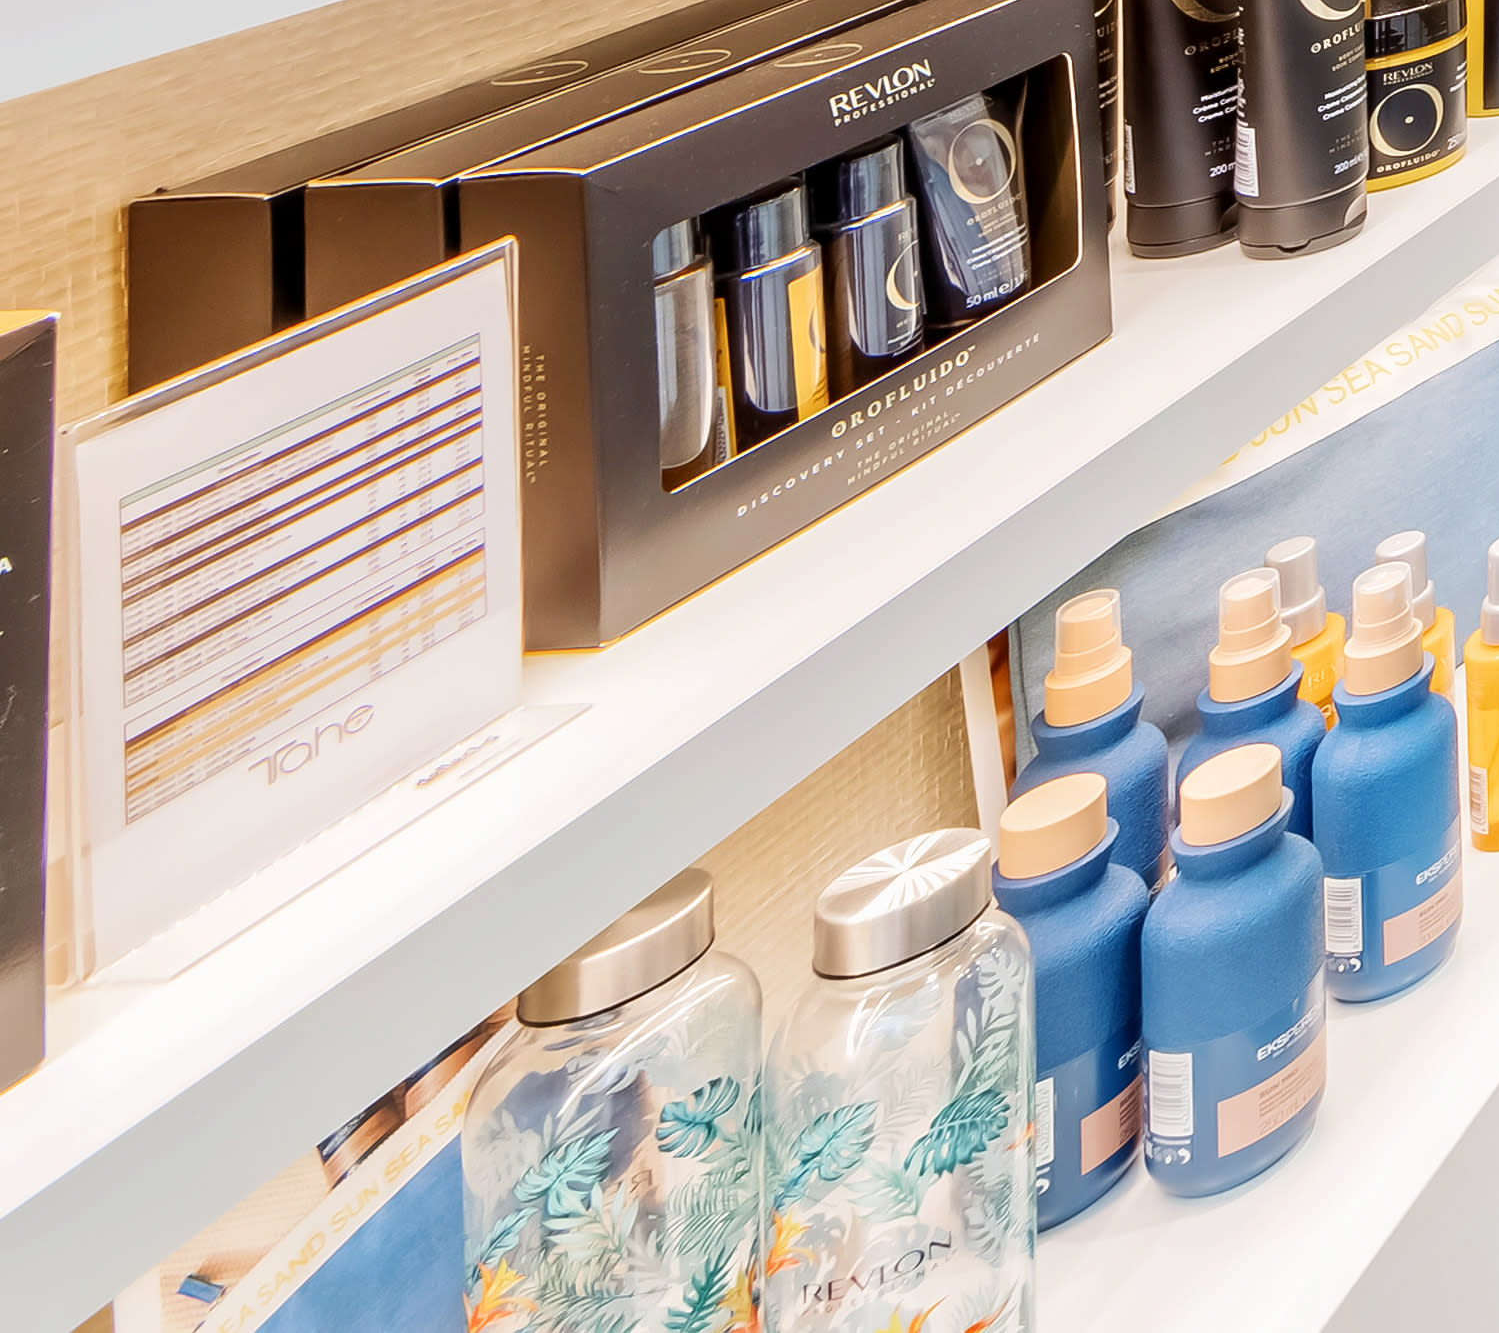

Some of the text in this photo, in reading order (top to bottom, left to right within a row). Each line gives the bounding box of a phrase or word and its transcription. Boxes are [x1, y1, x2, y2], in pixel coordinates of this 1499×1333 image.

[1310, 25, 1363, 55] OROFLU
[1382, 60, 1434, 84] REVLON
[829, 58, 933, 118] REVLON
[834, 78, 936, 127] PROFESSIONAL
[966, 293, 981, 308] 50
[1325, 358, 1392, 407] SEA
[1385, 312, 1466, 367] SAND
[535, 388, 549, 468] ORIGINAL
[736, 448, 846, 519] DISCOVERY
[856, 426, 887, 449] SET
[911, 394, 937, 417] KIT
[253, 1228, 331, 1300] SAND
[330, 1176, 381, 1233] SUN
[801, 1230, 954, 1305] REVLON
